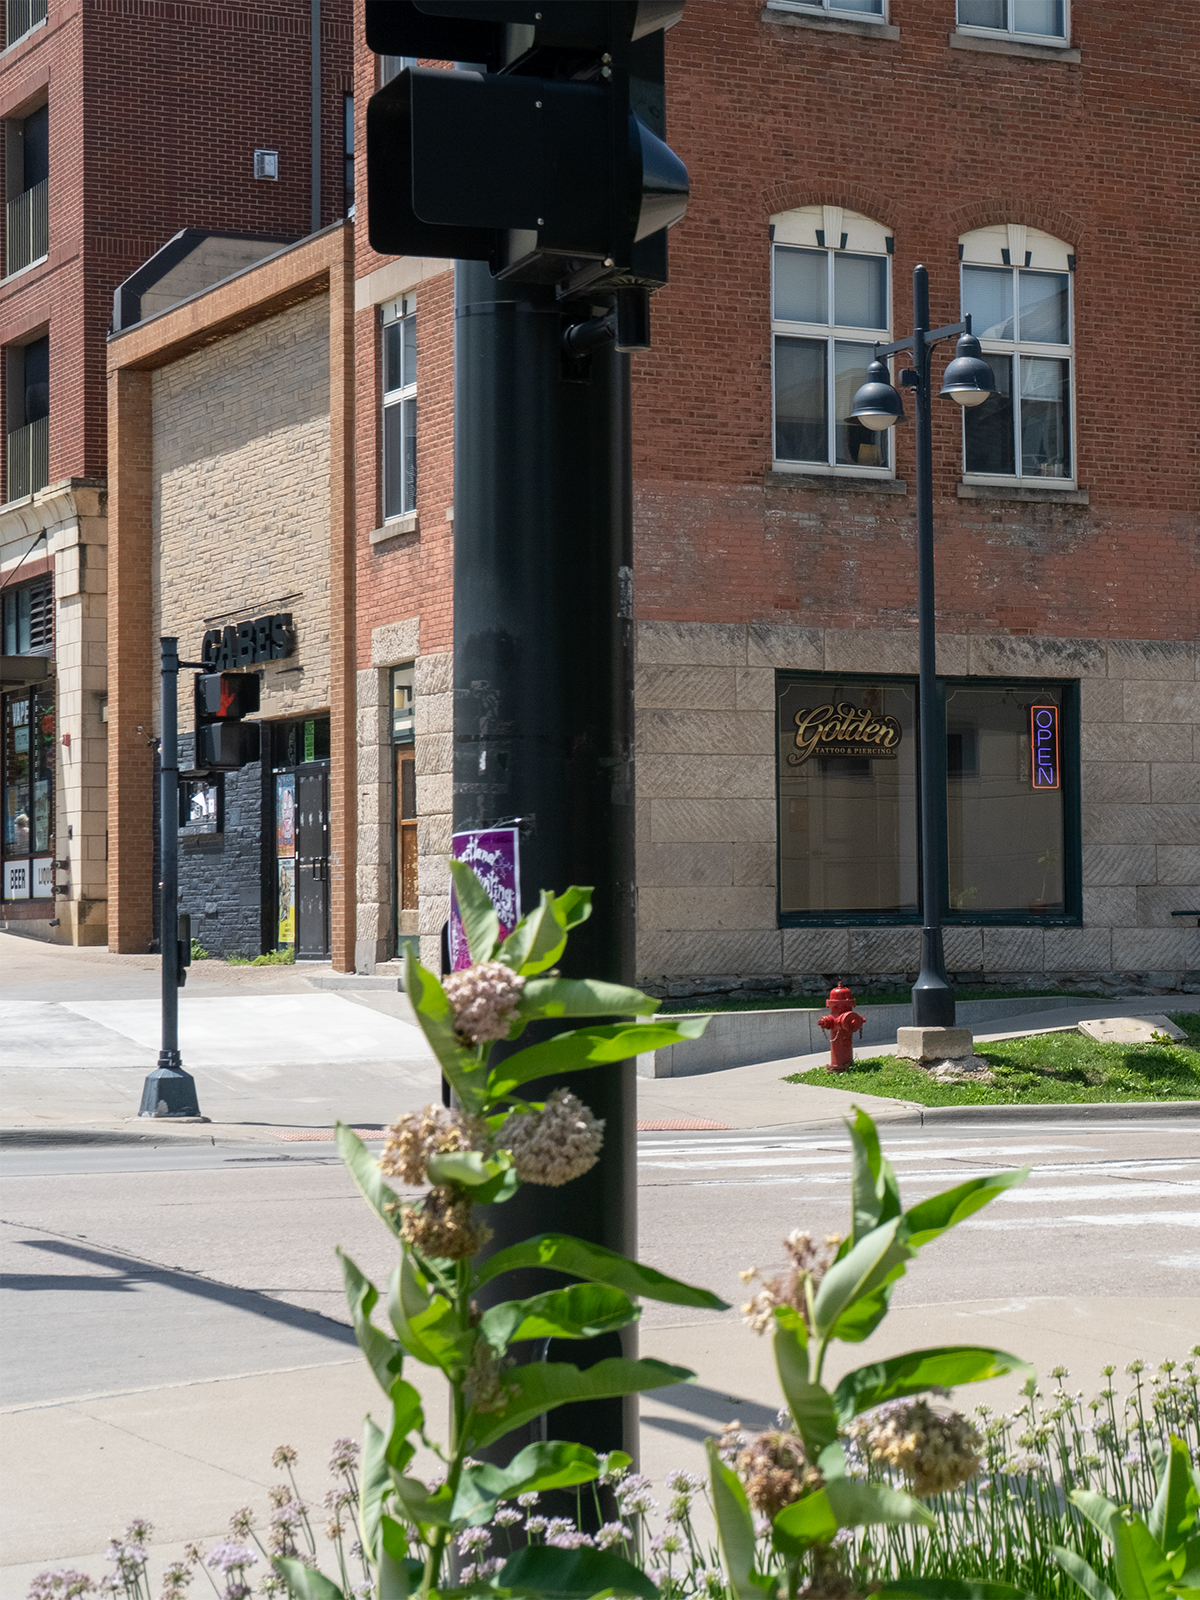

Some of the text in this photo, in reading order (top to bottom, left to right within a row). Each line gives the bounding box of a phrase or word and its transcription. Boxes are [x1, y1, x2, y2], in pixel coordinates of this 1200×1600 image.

[202, 613, 292, 671] GABES
[12, 700, 29, 727] VAPE
[788, 701, 900, 764] Golden
[1035, 710, 1054, 785] OPEN
[10, 868, 26, 889] BEER
